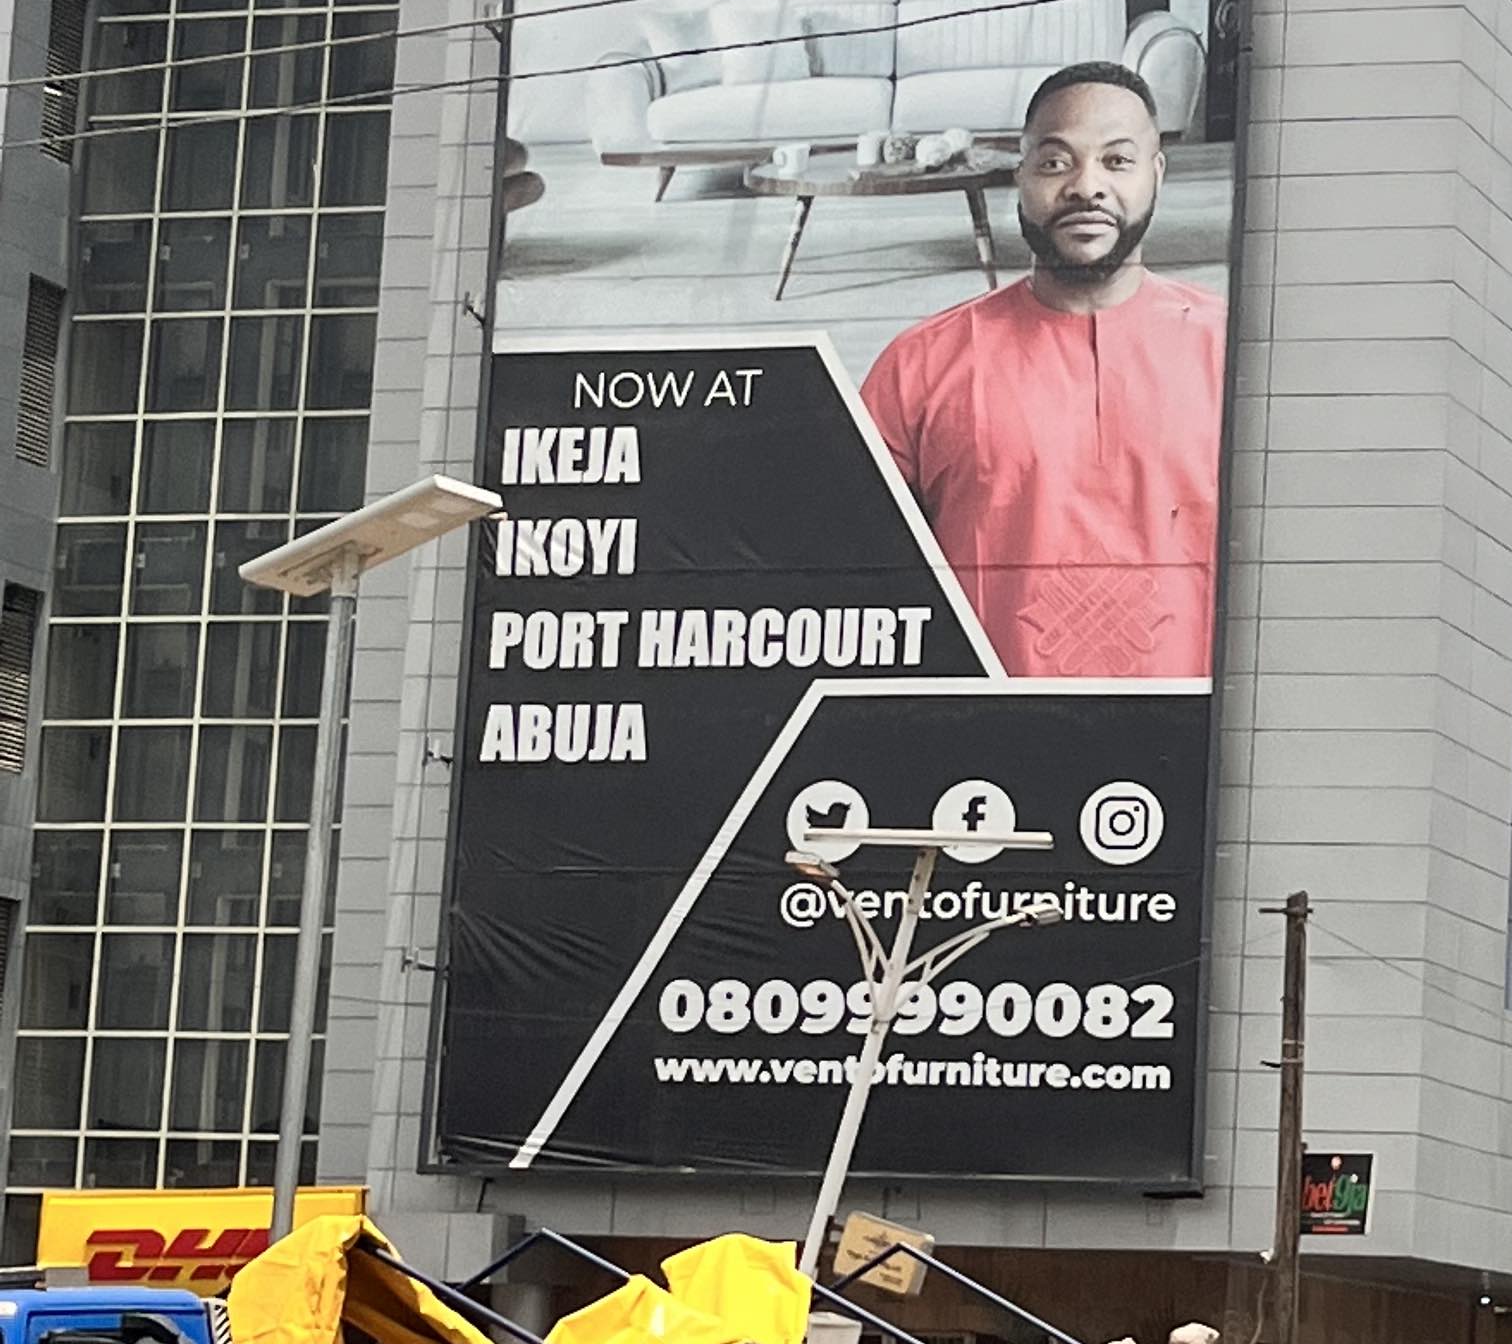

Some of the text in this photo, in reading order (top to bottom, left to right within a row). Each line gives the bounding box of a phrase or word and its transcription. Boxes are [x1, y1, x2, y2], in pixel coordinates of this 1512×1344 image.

[573, 368, 764, 409] NOW AT
[501, 426, 642, 485] IKEJA
[495, 518, 638, 577] IKOYI
[488, 607, 932, 670] PORT HARCOURT
[479, 703, 648, 763] ABUJA
[780, 880, 1178, 928] @ventofurniture
[658, 978, 1175, 1039] 08099990082
[654, 1051, 1172, 1090] www.ventofurniture.com
